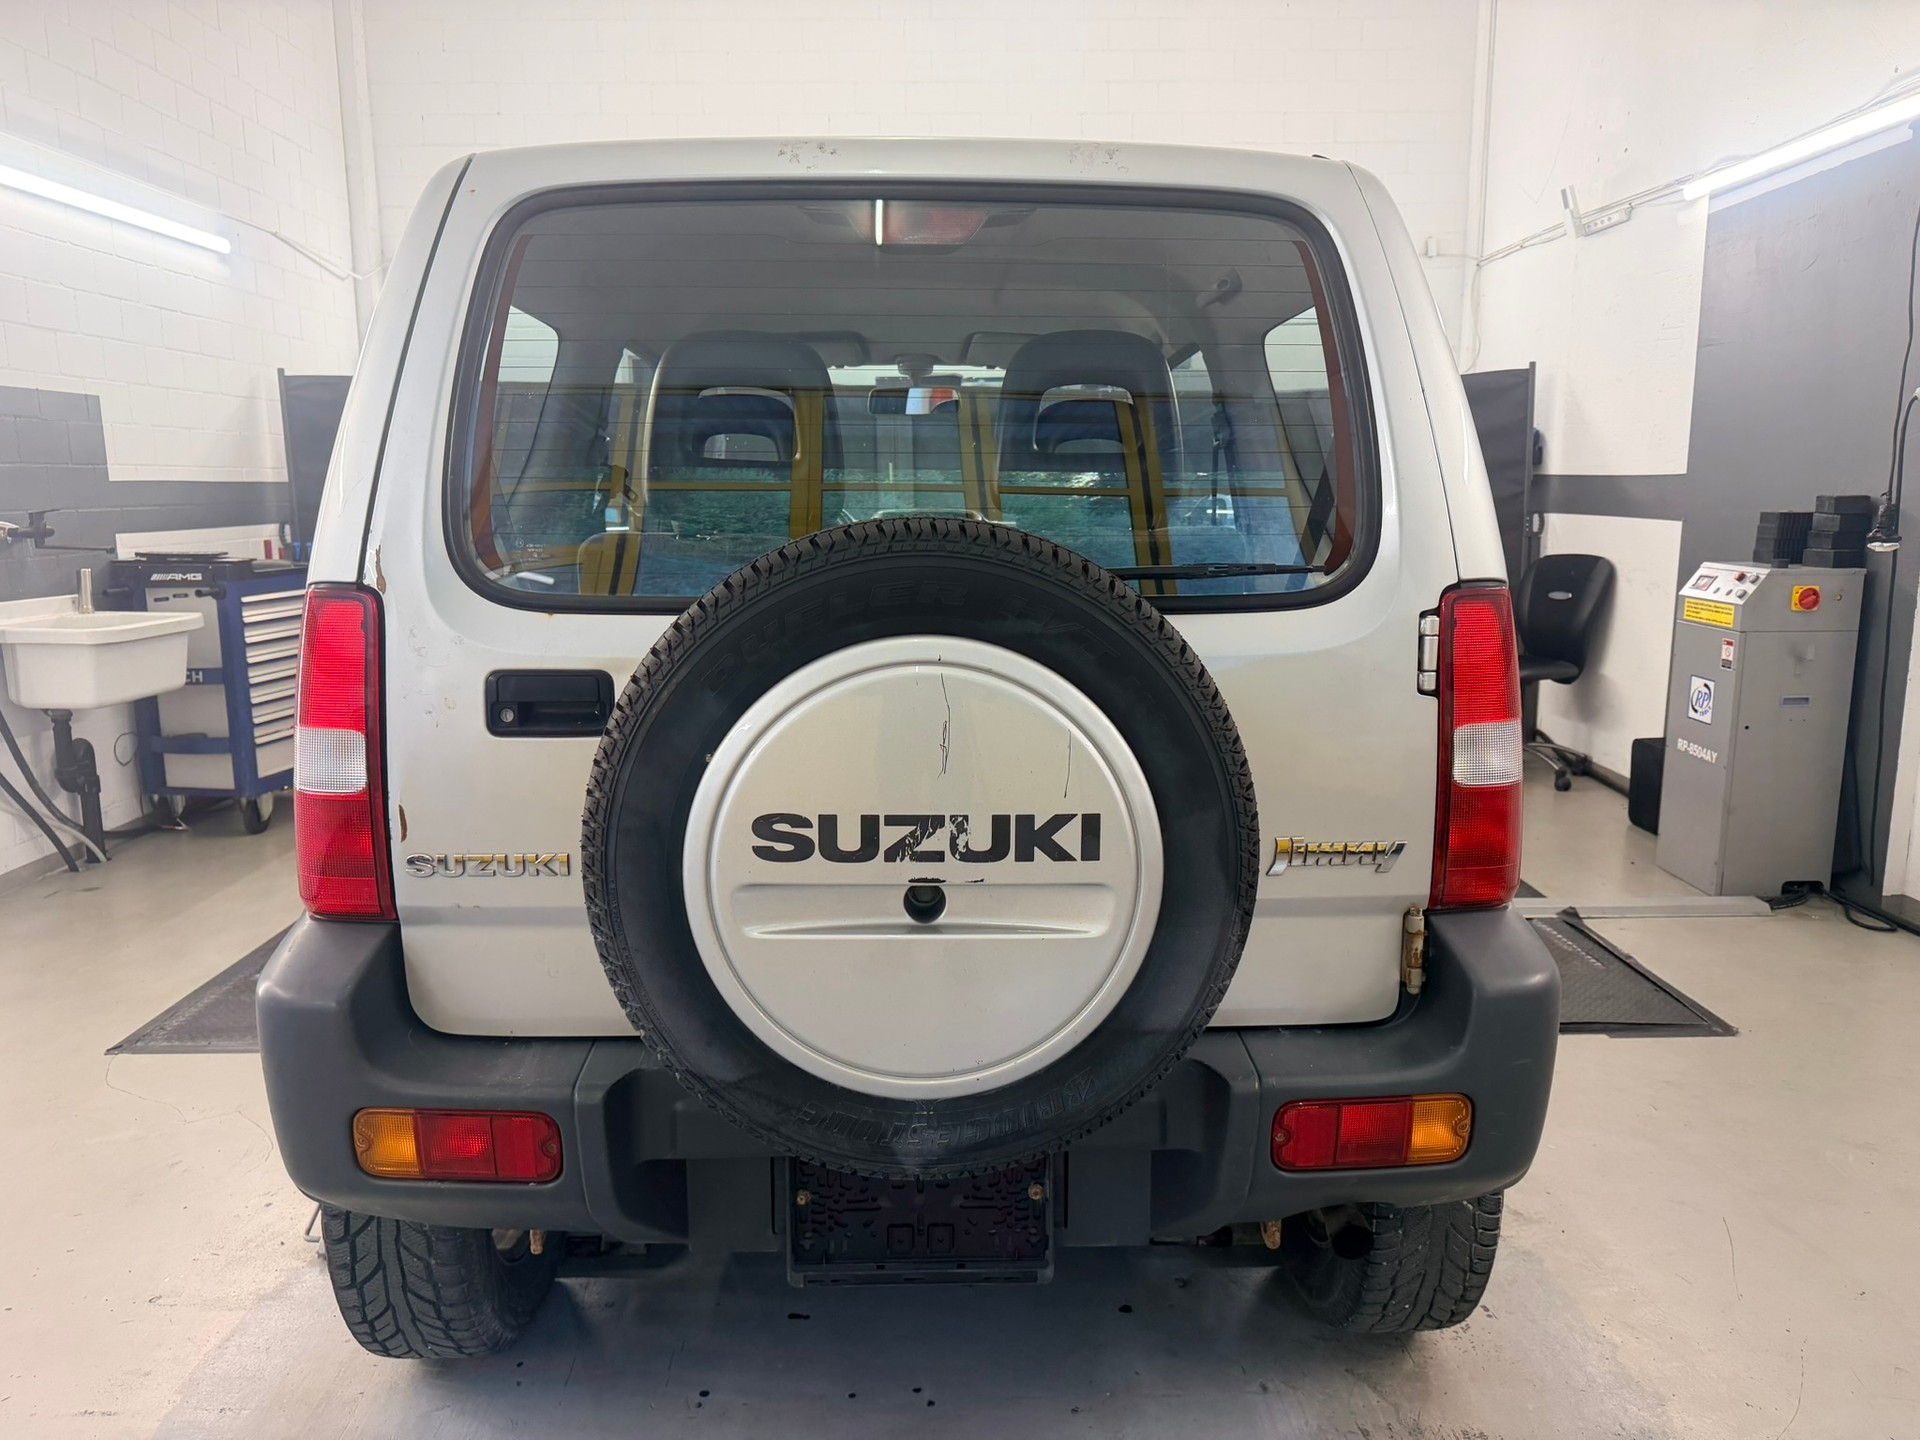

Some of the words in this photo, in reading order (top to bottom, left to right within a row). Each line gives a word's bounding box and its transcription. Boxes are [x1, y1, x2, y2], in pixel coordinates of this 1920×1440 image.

[167, 572, 202, 581] AMG
[1695, 690, 1709, 709] RP
[751, 812, 1101, 863] SUZUKI
[405, 852, 571, 878] SUZUKI
[1266, 836, 1408, 876] Jimny
